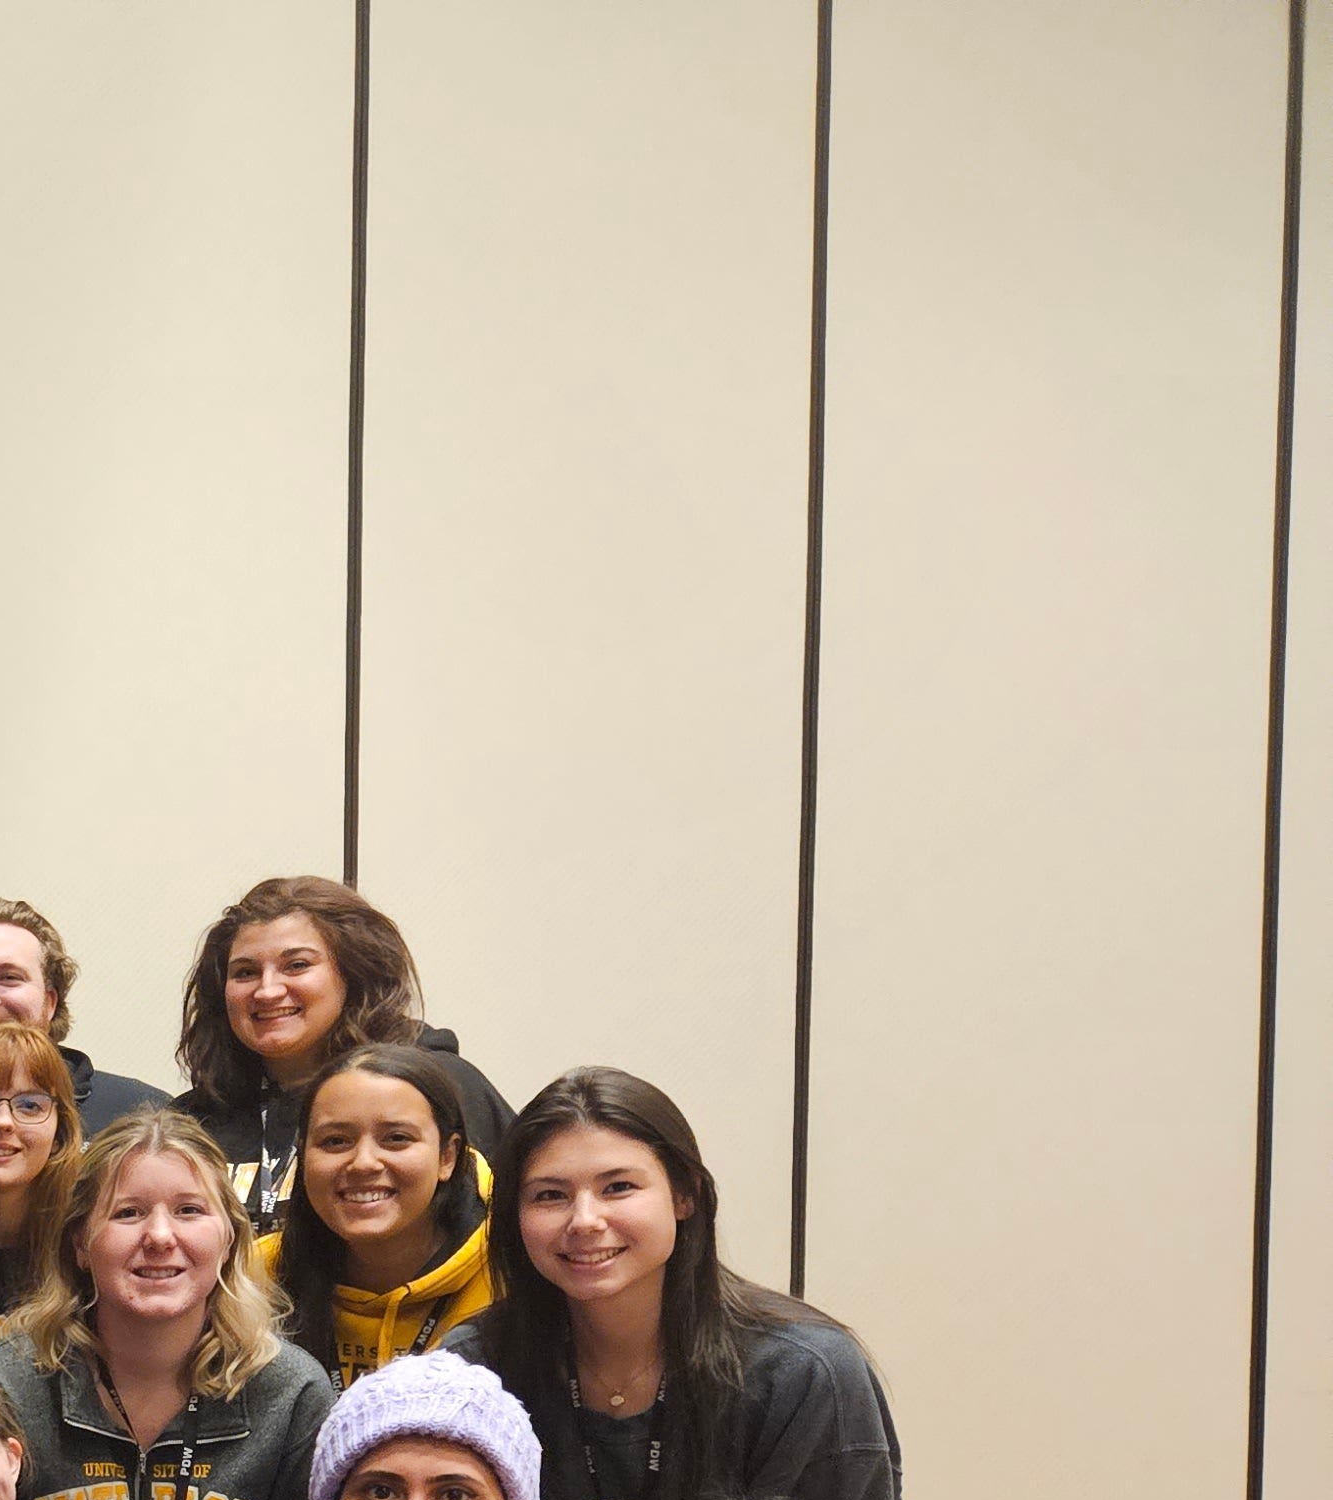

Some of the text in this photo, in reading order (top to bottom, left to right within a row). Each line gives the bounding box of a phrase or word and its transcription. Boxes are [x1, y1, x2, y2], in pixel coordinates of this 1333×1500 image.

[417, 1319, 435, 1345] PDW
[180, 1447, 194, 1476] PDW
[649, 1440, 661, 1472] PDW
[193, 1464, 211, 1478] OF
